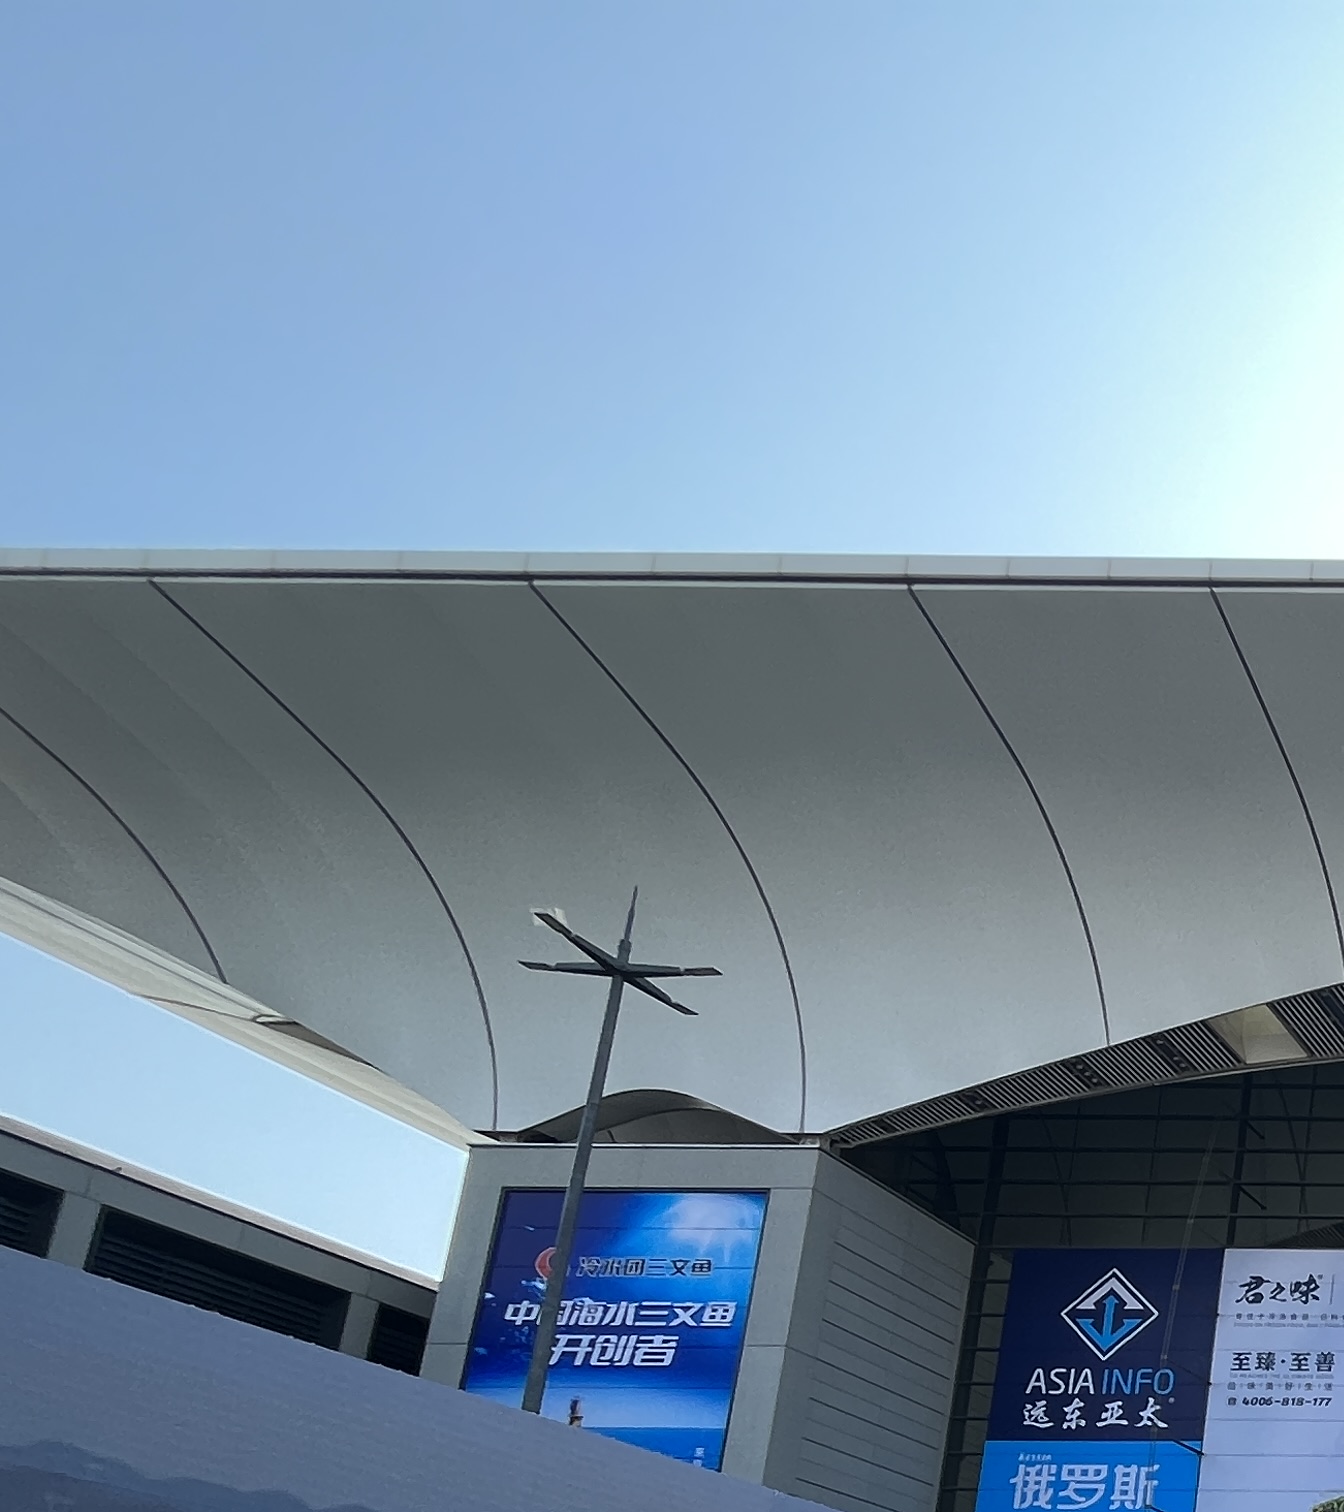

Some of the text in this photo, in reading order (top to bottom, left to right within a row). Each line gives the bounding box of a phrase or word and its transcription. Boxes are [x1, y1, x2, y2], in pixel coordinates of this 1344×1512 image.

[1235, 1274, 1320, 1305] 君之味
[549, 1334, 680, 1367] 开创者
[1025, 1368, 1176, 1396] ASIA INFO
[1022, 1398, 1170, 1430] 远东亚太
[1009, 1464, 1160, 1510] 俄罗斯
